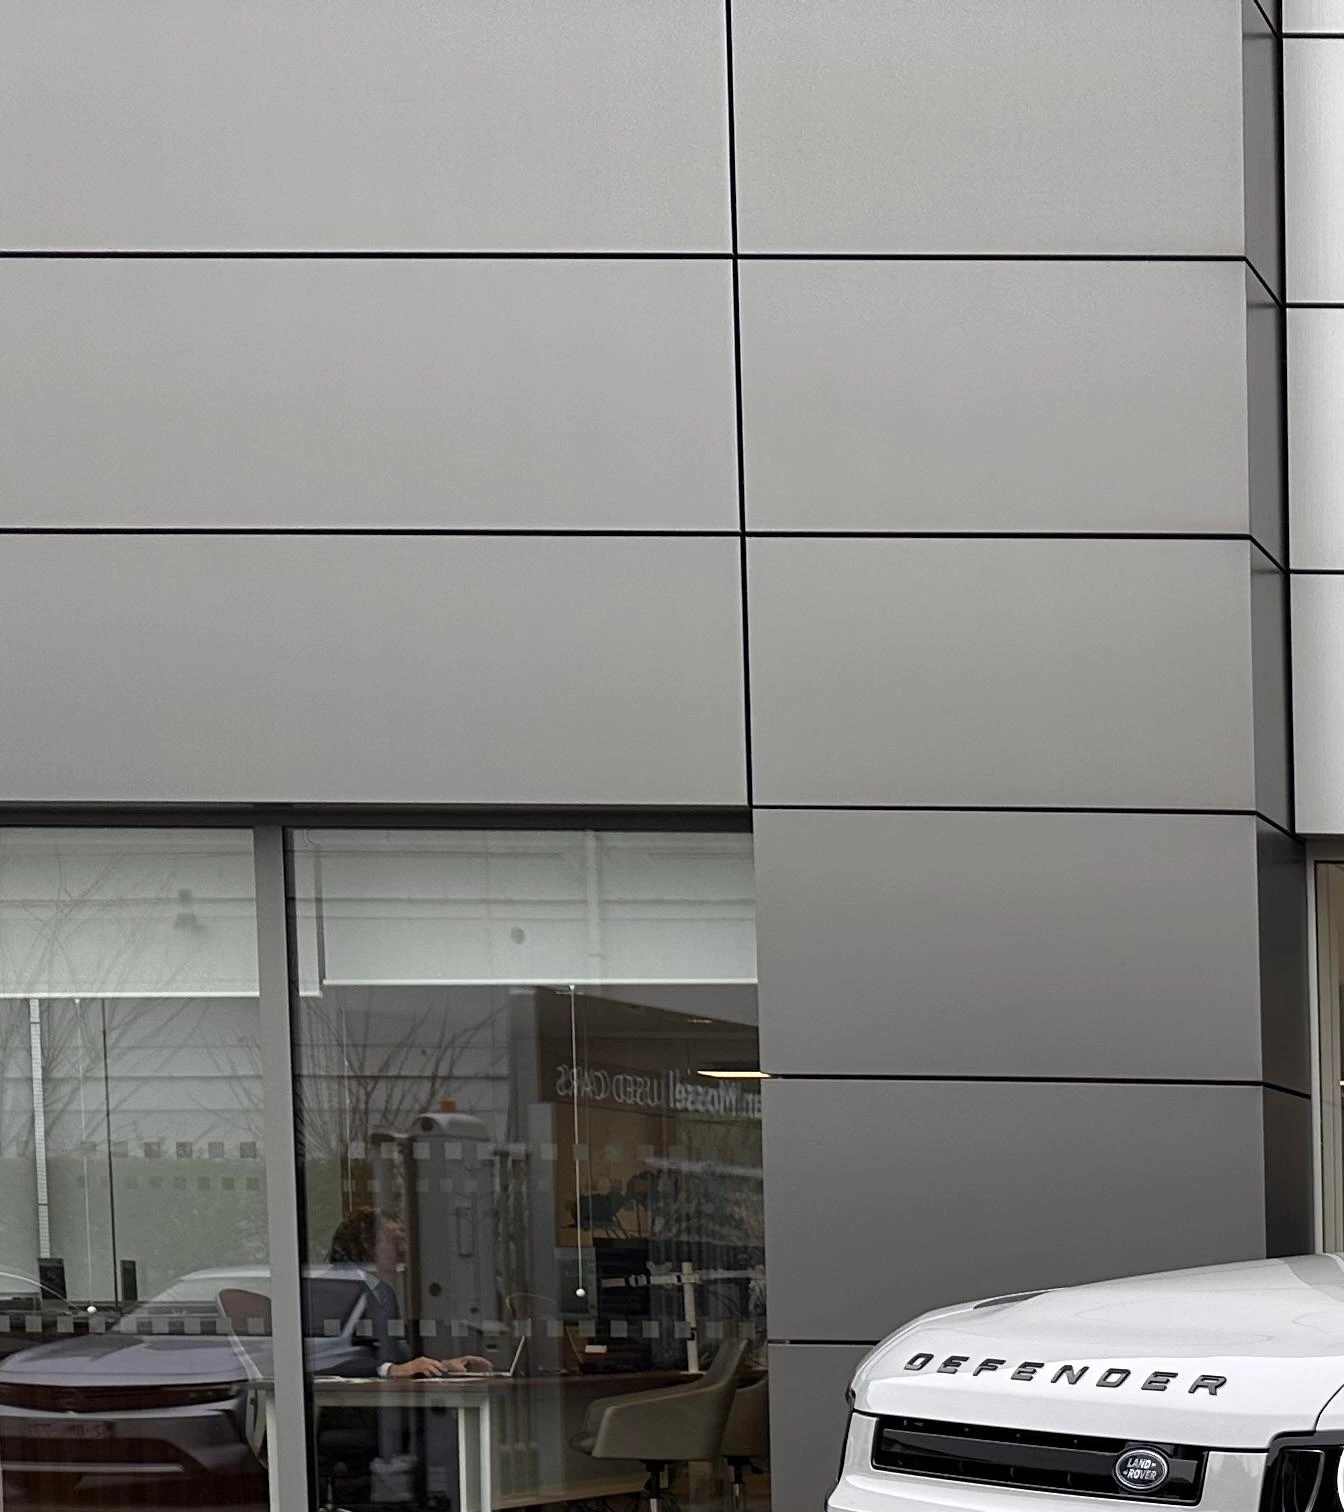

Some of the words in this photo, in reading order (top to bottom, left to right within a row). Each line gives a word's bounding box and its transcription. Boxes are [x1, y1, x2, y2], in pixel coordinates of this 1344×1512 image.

[903, 1351, 1228, 1397] DEFENDER
[1126, 1457, 1152, 1470] LAND
[1127, 1468, 1157, 1481] ROVER
